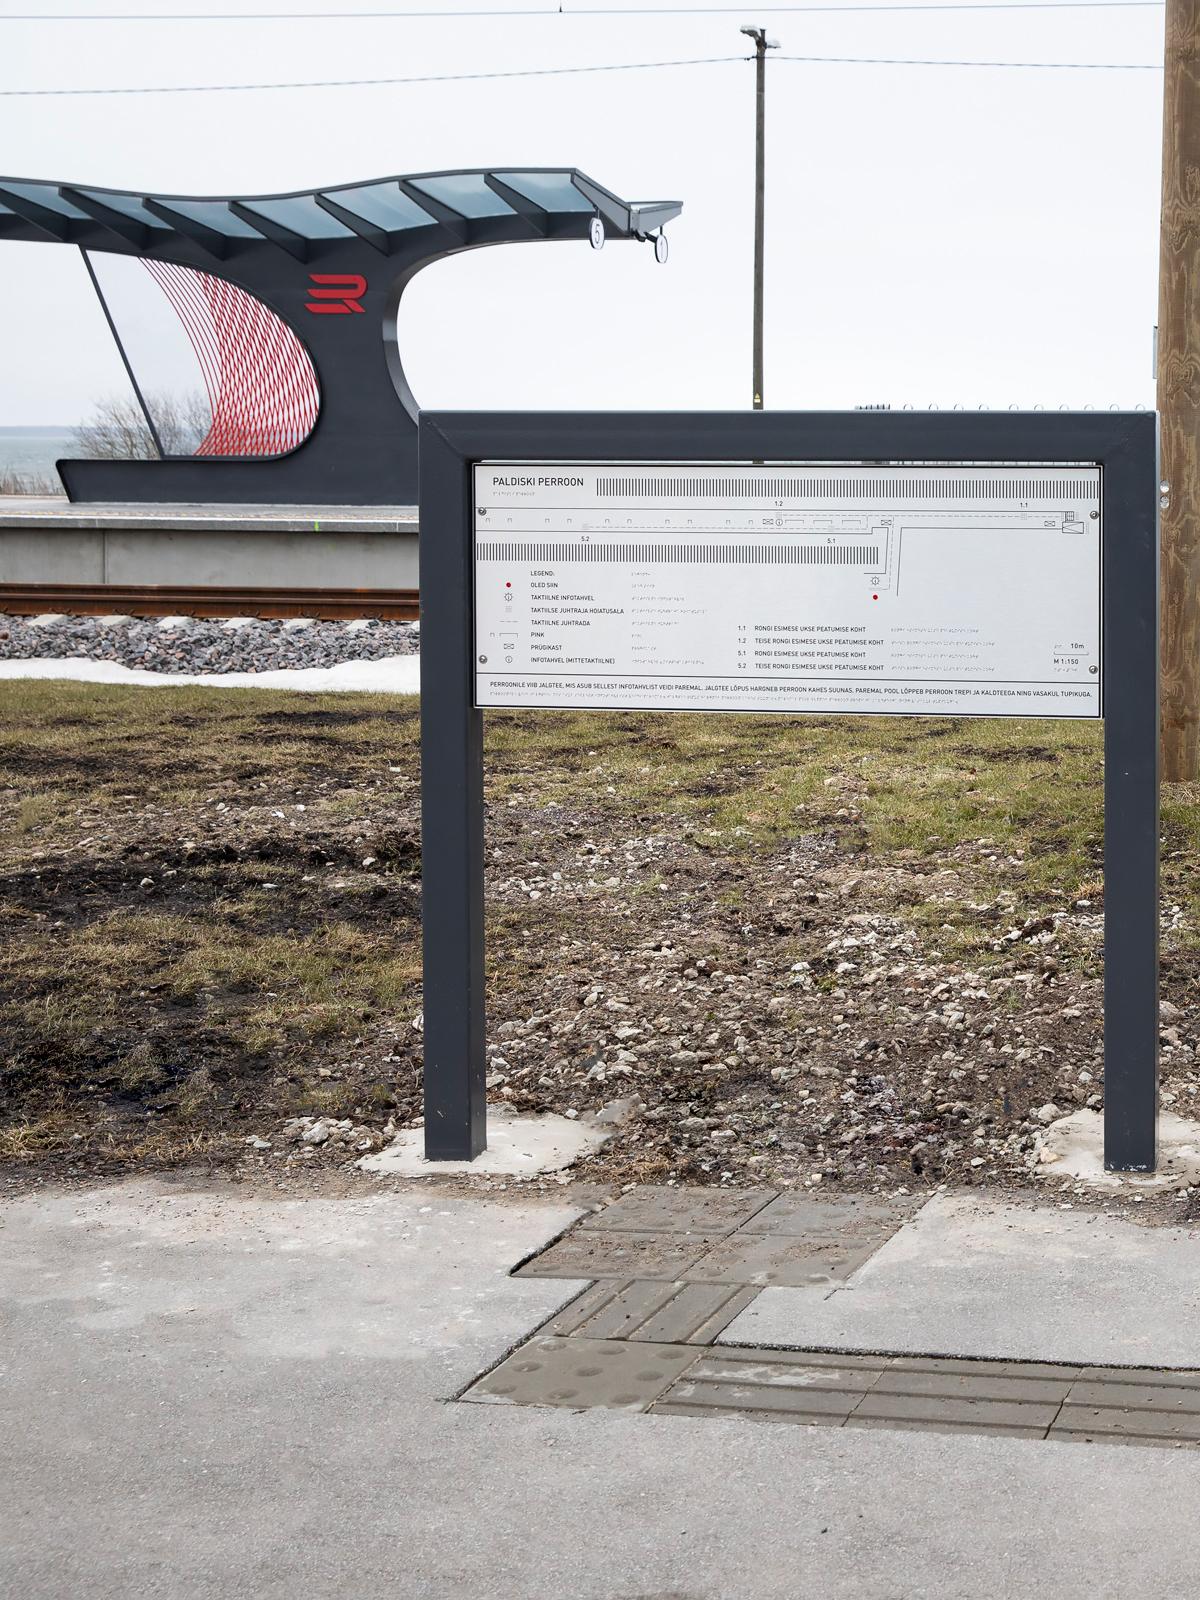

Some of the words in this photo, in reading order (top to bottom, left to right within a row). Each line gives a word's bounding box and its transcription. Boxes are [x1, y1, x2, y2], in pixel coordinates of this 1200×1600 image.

[595, 223, 601, 244] 5
[492, 477, 536, 486] PALDISKI
[538, 477, 584, 487] PERROON
[530, 643, 562, 651] PRÜGIKAST
